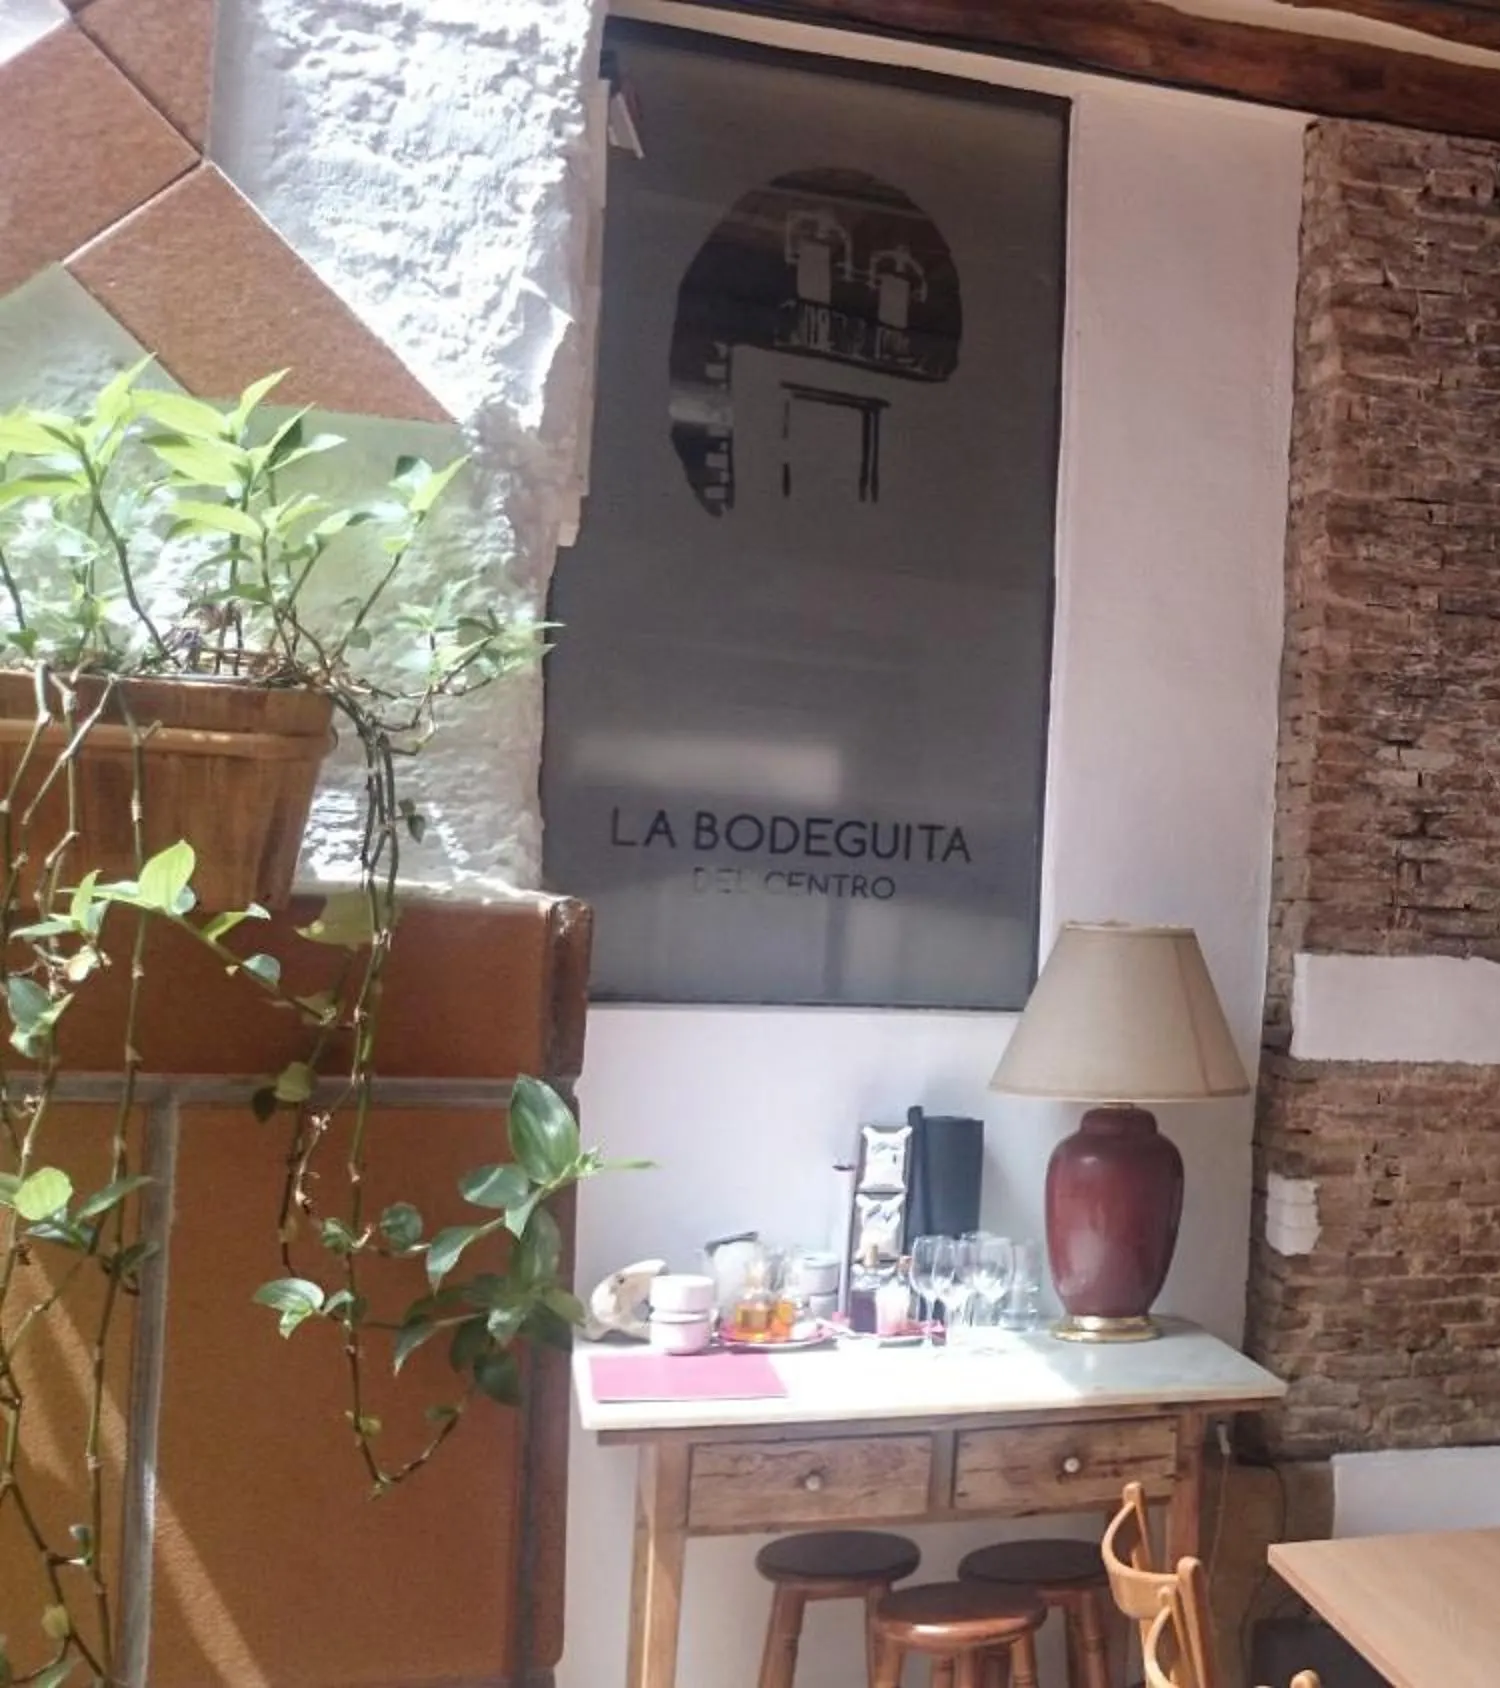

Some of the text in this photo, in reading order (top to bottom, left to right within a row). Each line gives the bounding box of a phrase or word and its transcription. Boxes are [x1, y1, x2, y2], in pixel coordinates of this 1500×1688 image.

[611, 806, 972, 864] LA BODEGUITA
[764, 871, 896, 900] CENTRO
